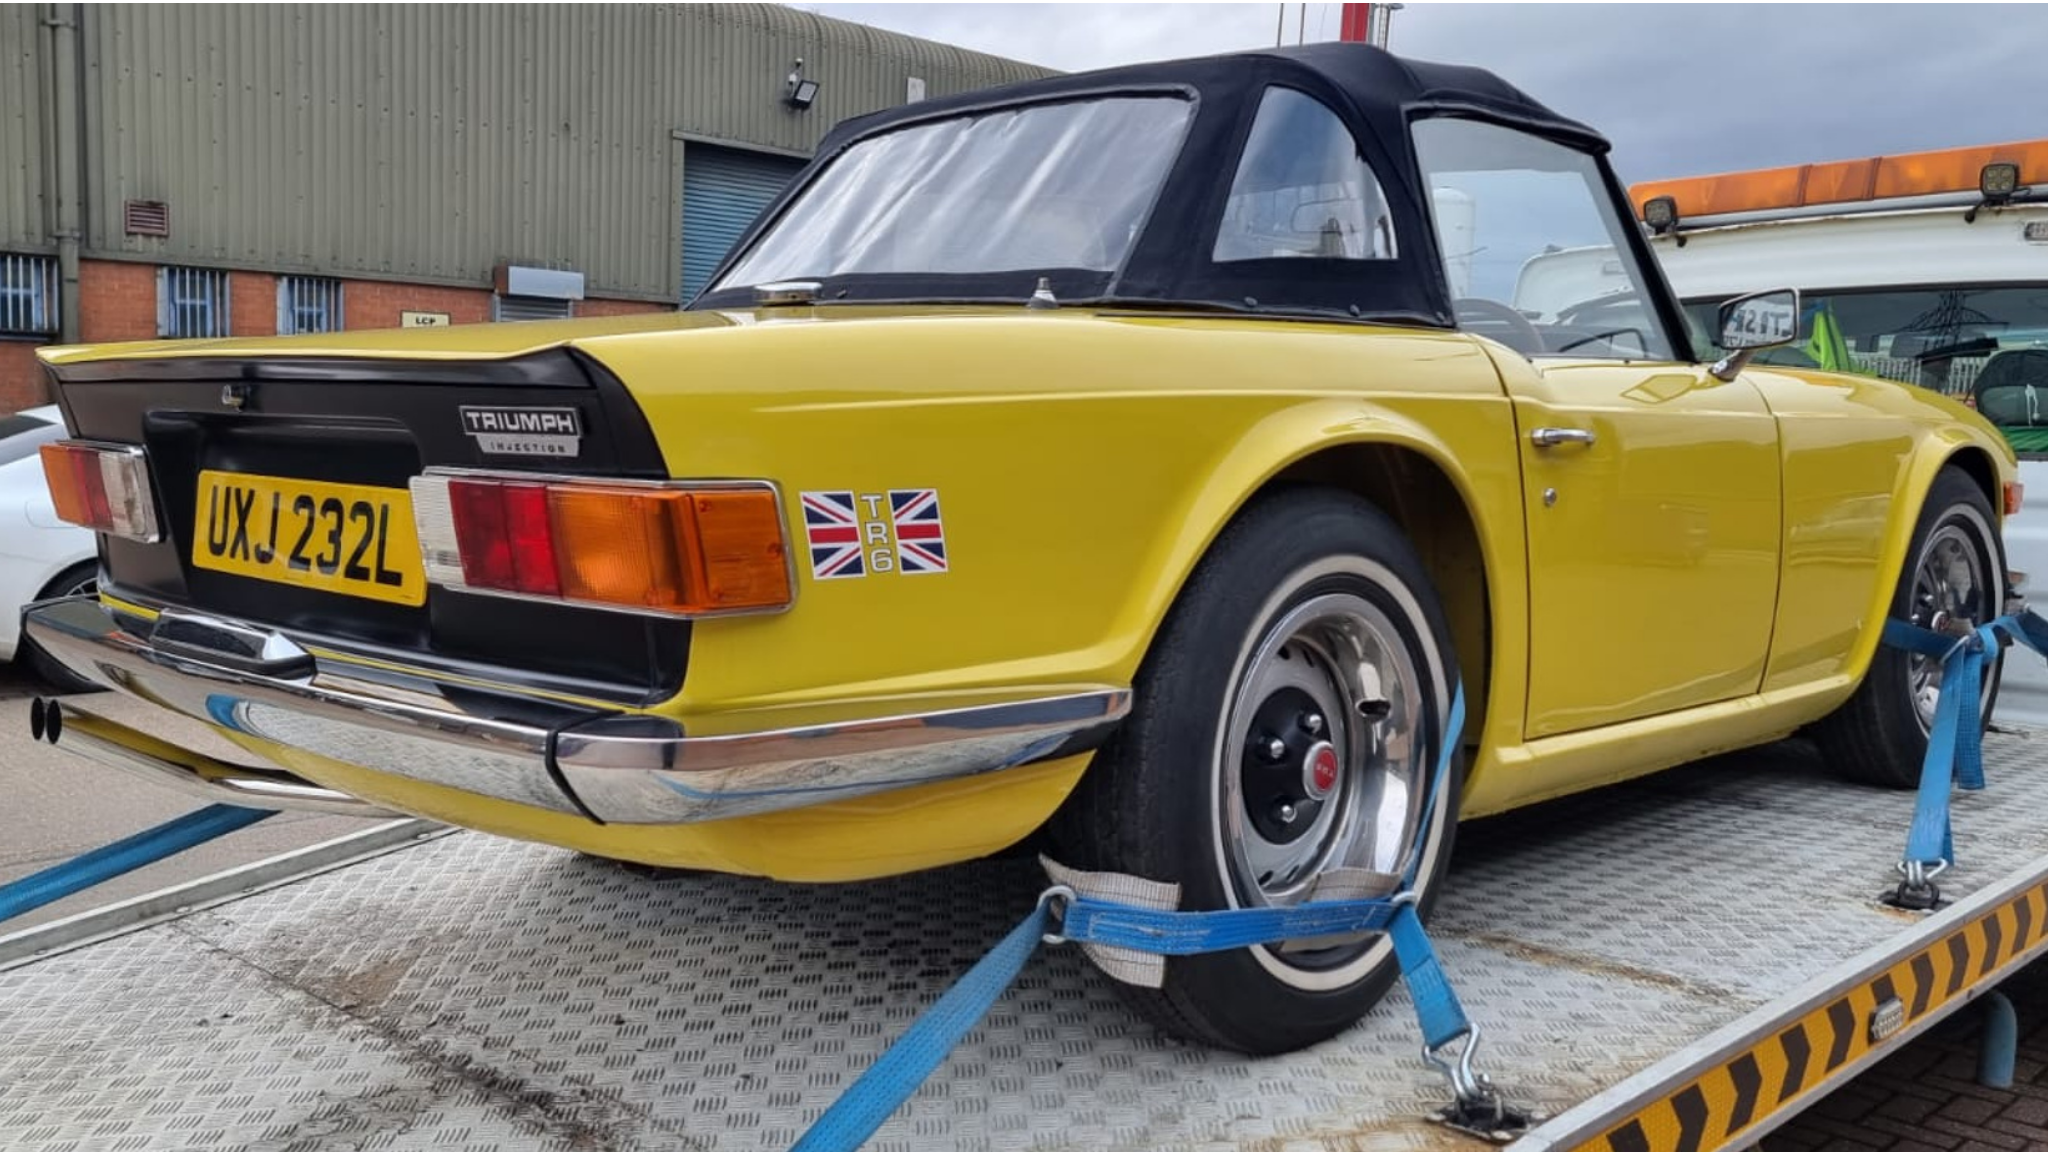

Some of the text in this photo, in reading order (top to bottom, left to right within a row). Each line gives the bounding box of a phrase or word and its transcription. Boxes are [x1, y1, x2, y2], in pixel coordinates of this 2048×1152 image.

[466, 411, 574, 432] TRIUMPH
[490, 442, 566, 453] INJECTION
[208, 485, 403, 587] UXJ 232L
[860, 493, 893, 573] TR6
